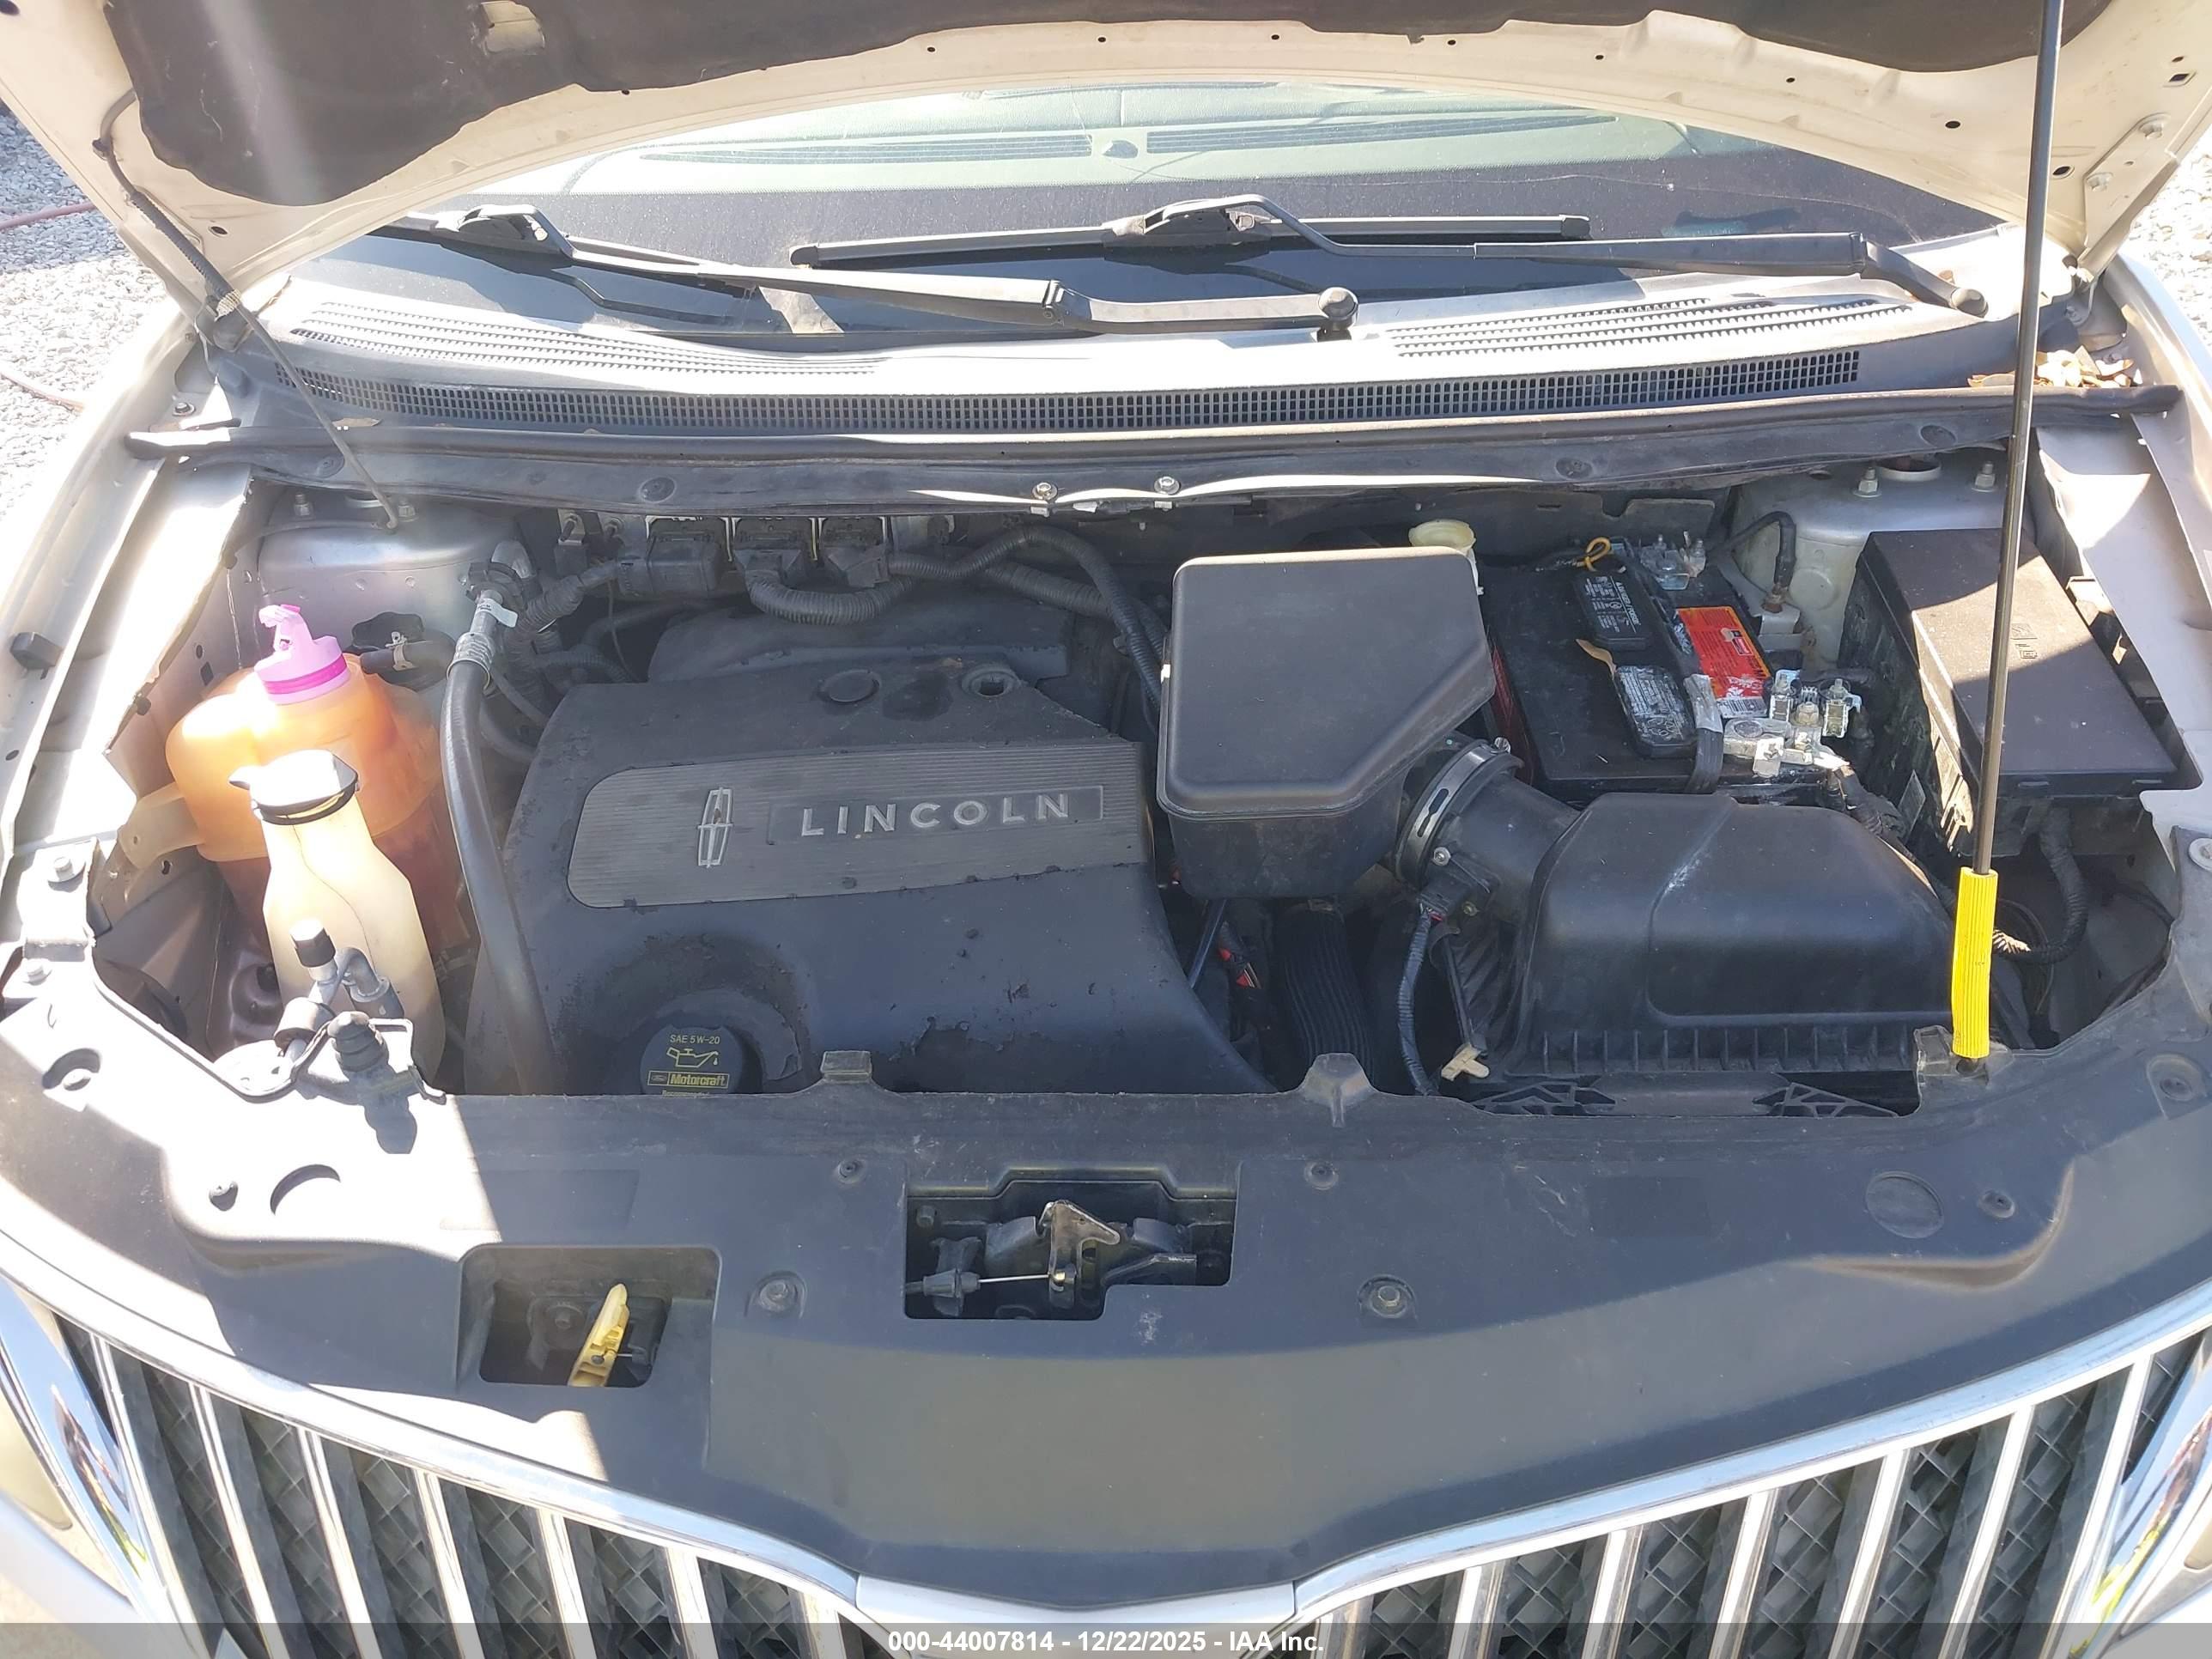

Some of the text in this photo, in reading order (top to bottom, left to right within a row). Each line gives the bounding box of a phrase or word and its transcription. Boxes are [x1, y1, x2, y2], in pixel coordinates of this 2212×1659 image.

[800, 793, 1070, 837] LINCOLN
[670, 1034, 720, 1045] SAE 5W-20
[670, 1073, 726, 1086] Motorcraft
